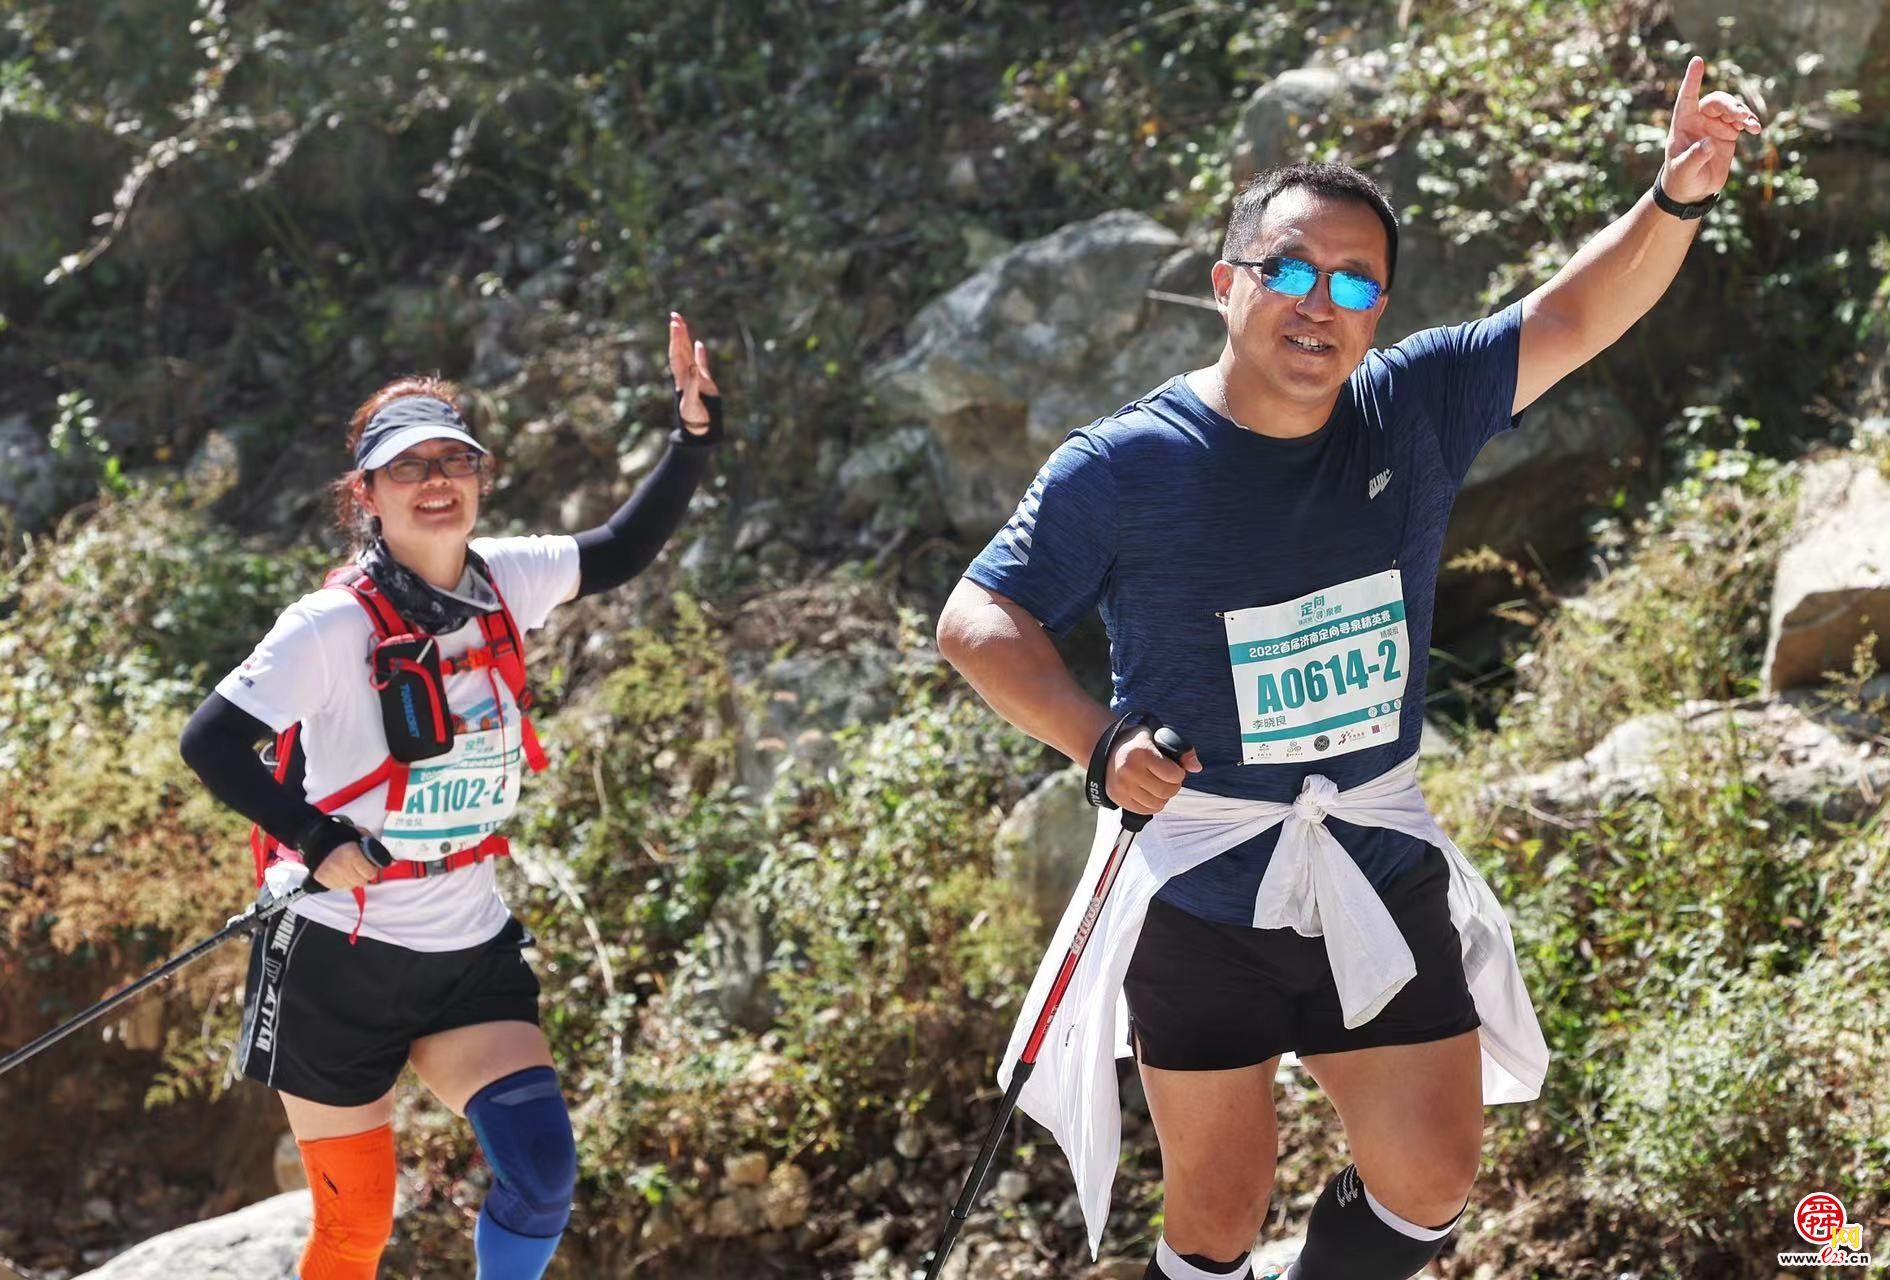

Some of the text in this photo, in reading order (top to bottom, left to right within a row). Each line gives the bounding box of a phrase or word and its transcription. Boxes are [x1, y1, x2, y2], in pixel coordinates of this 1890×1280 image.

[1301, 594, 1325, 617] 定向
[1249, 610, 1391, 658] 2022首届济南定向寻泉精英赛
[1257, 639, 1402, 715] A0614-2
[1252, 715, 1288, 730] 李晓良
[405, 775, 508, 814] A1102-2
